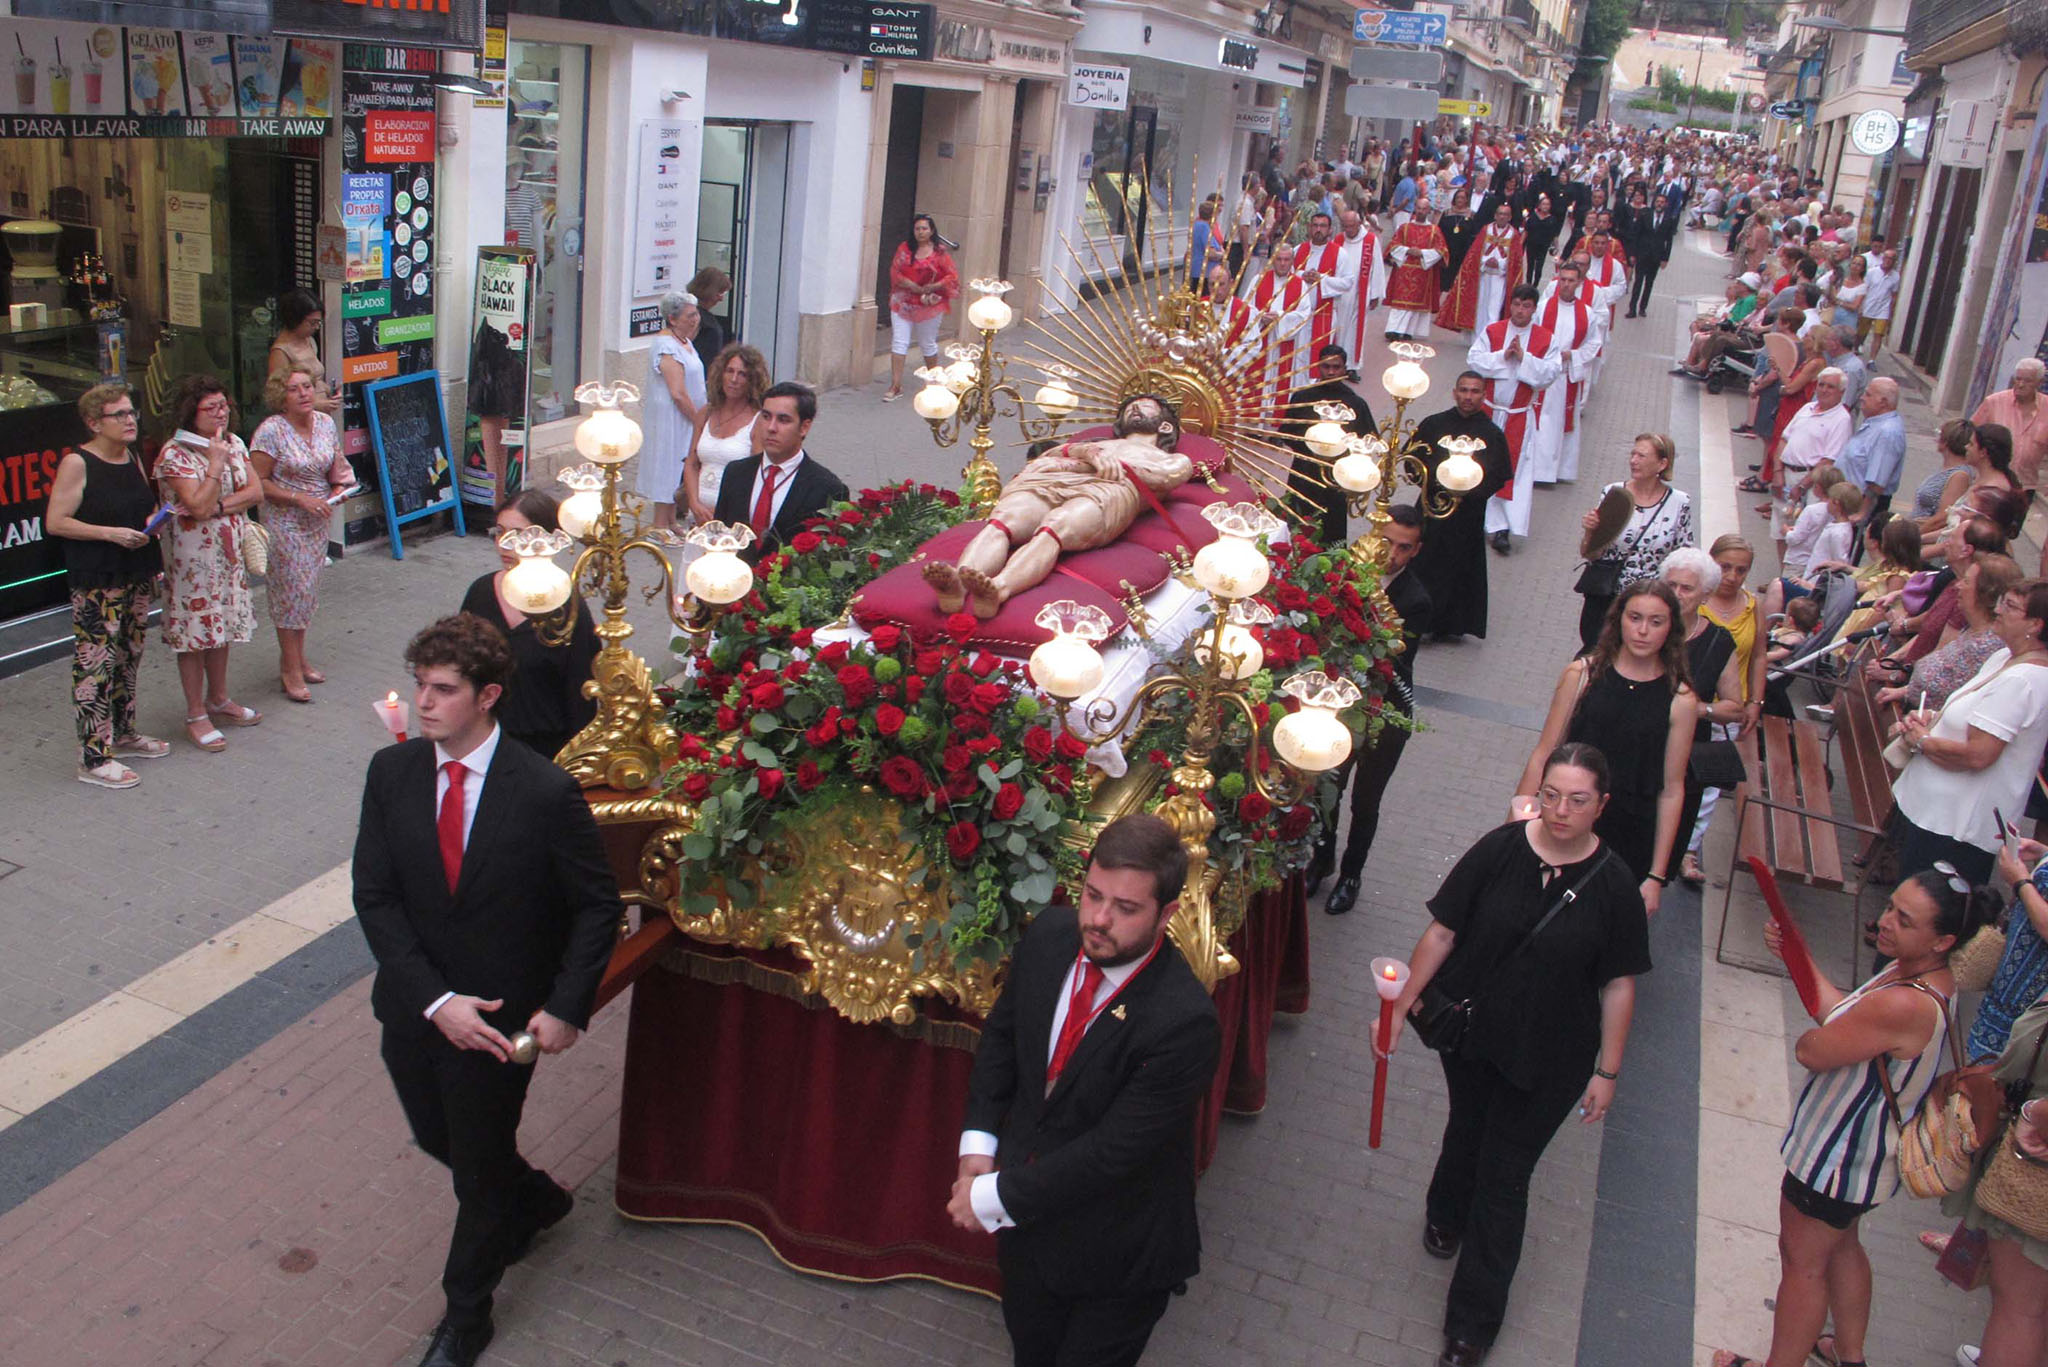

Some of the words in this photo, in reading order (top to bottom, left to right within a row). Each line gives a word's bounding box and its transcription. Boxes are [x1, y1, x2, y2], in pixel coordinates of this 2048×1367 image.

[871, 7, 921, 18] GANT
[889, 25, 917, 33] TOMMY
[130, 33, 175, 49] GELATO
[887, 32, 919, 40] HILFIGER
[869, 42, 896, 55] Calvin
[897, 44, 918, 56] Klein
[1074, 68, 1125, 81] JOYERÍA
[371, 81, 391, 93] TAKE
[392, 83, 414, 94] AWAY
[1073, 82, 1120, 104] Bonilla
[386, 95, 407, 107] PARA
[407, 96, 434, 107] LLEVAR
[13, 119, 67, 137] PARA
[72, 119, 141, 137] LLEVAR
[241, 119, 280, 136] TAKE
[283, 119, 325, 136] AWAY
[1867, 120, 1887, 132] BH
[374, 132, 385, 143] DE
[387, 132, 425, 144] HELADOS
[1865, 132, 1884, 145] HS
[373, 145, 416, 155] NATURALES
[349, 177, 385, 188] RECETAS
[350, 190, 385, 200] PROPIAS
[345, 203, 381, 216] Orxata
[481, 276, 515, 296] BLACK
[348, 298, 385, 310] HELADOS
[480, 294, 515, 313] HAWAII
[384, 322, 431, 337] GRANIZADOS
[352, 360, 388, 375] BATIDOS
[0, 516, 43, 551] AM
